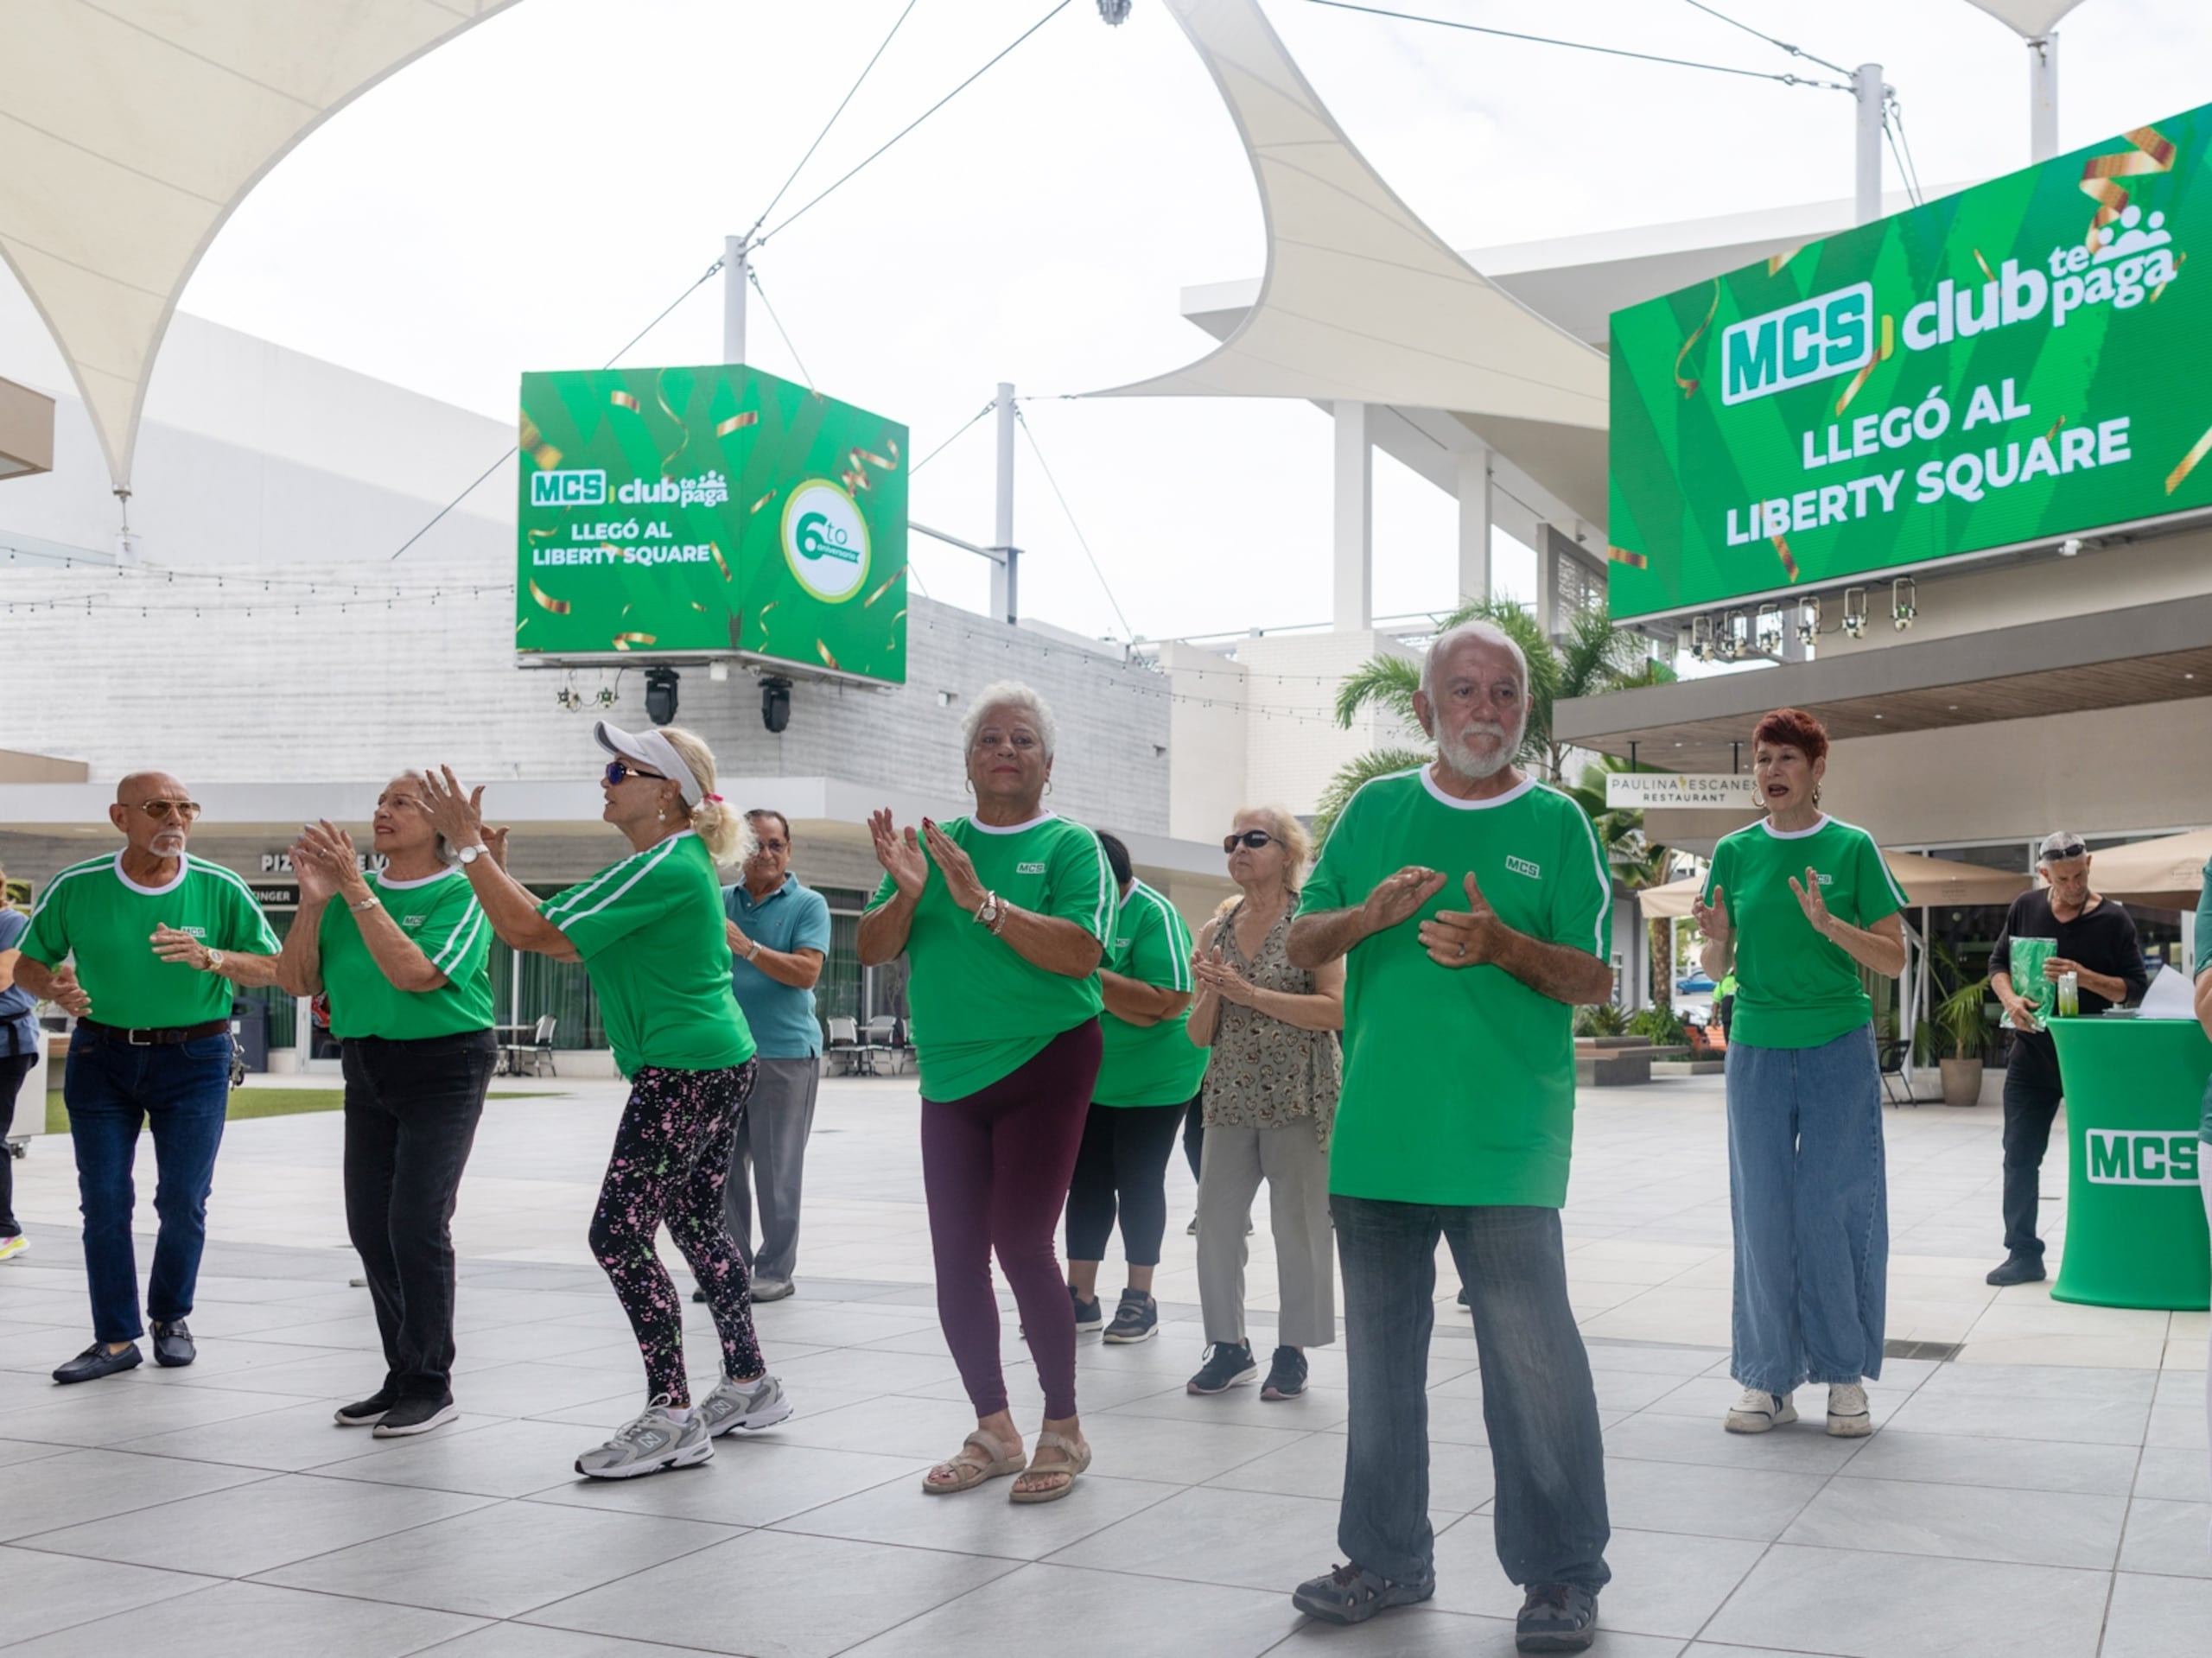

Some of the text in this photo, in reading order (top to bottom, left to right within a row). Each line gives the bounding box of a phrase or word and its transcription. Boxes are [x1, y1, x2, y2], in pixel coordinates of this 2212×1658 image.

[2047, 245, 2089, 278] te
[2051, 247, 2178, 328] paga
[1728, 258, 2048, 397] MCS club
[1802, 378, 2031, 470] LLEGÓ AL
[534, 473, 680, 504] MCS club
[679, 477, 696, 490] te
[1726, 416, 2132, 546] LIBERTY SQUARE
[680, 487, 729, 508] paga
[571, 518, 673, 541] LLEGÓ AL
[532, 544, 710, 567] LIBERTY SQUARE
[1611, 779, 1678, 791] PAULINA
[1643, 793, 1726, 802] RESTAURANT
[1018, 863, 1045, 873] MCS
[1507, 856, 1539, 877] MCS
[2090, 1134, 2199, 1181] MCS
